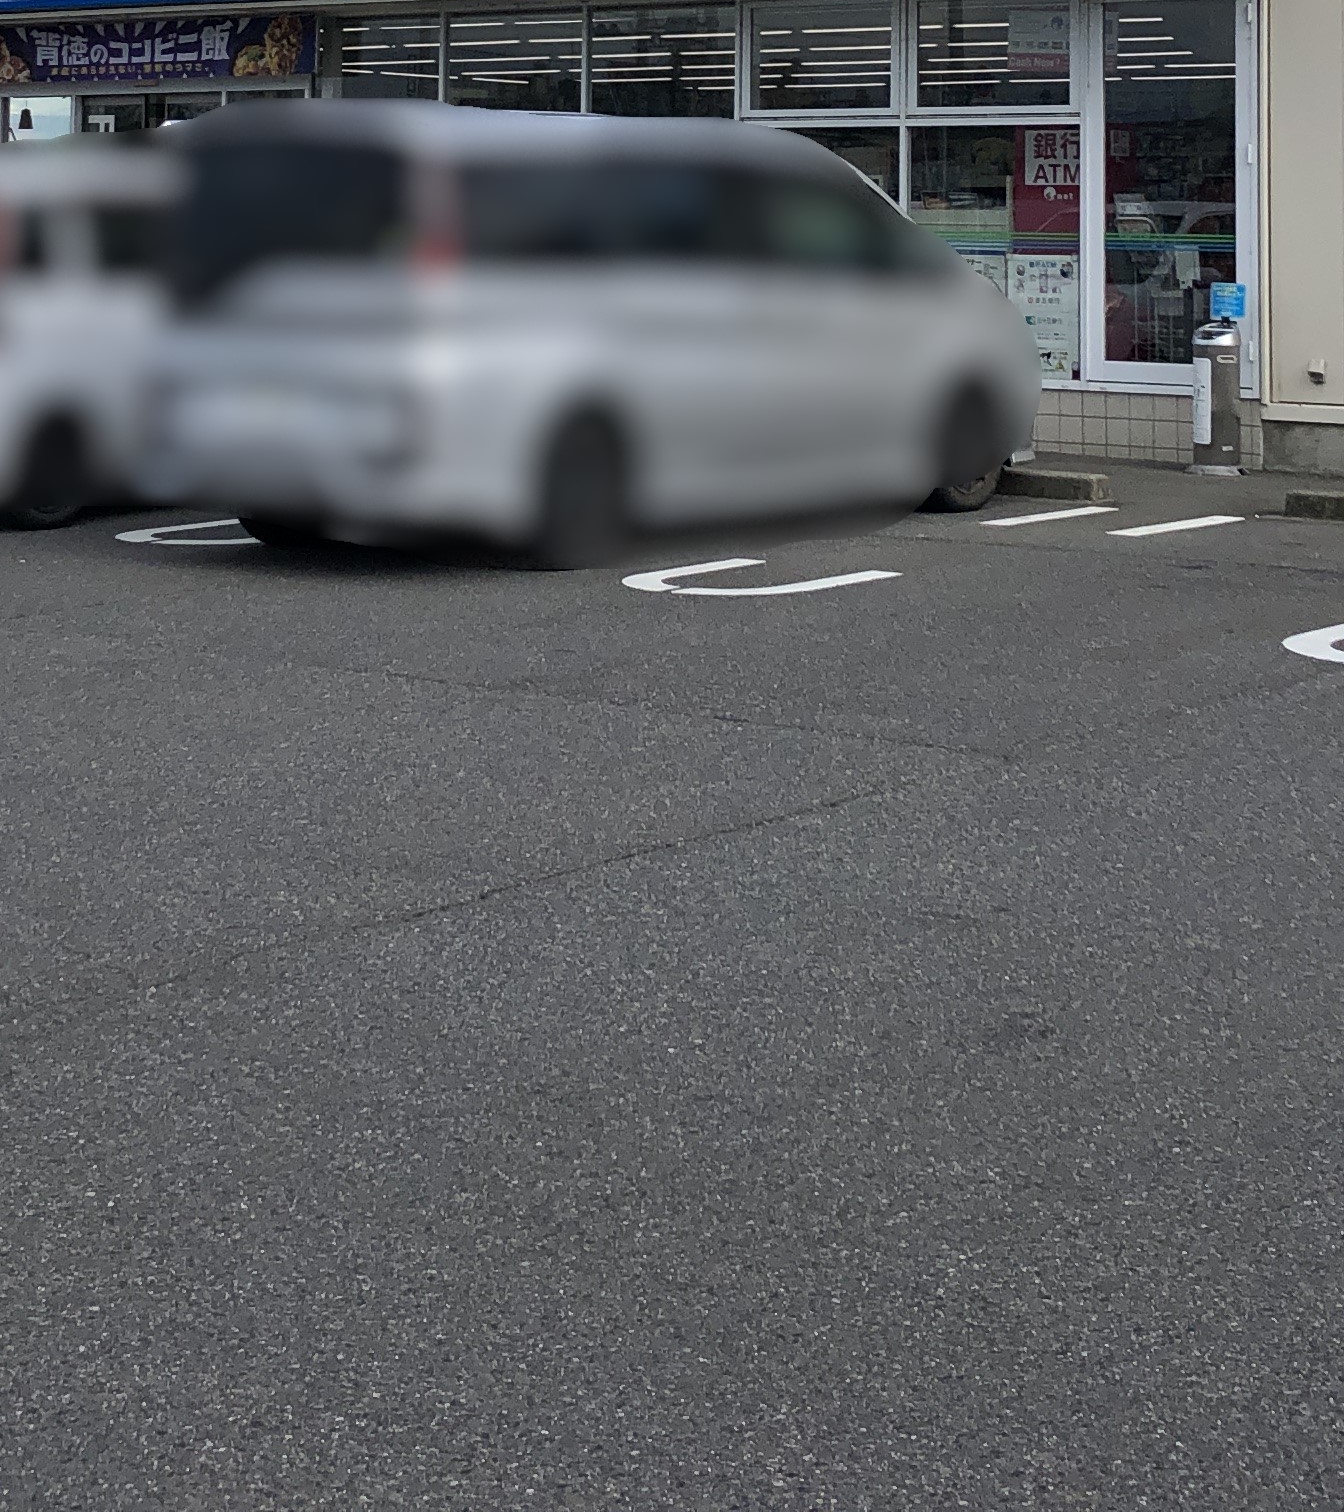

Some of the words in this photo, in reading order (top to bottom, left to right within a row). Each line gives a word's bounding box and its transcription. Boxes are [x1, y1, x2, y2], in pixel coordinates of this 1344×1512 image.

[29, 19, 233, 66] 背徳のコンビニ飯
[1033, 132, 1080, 160] 銀行
